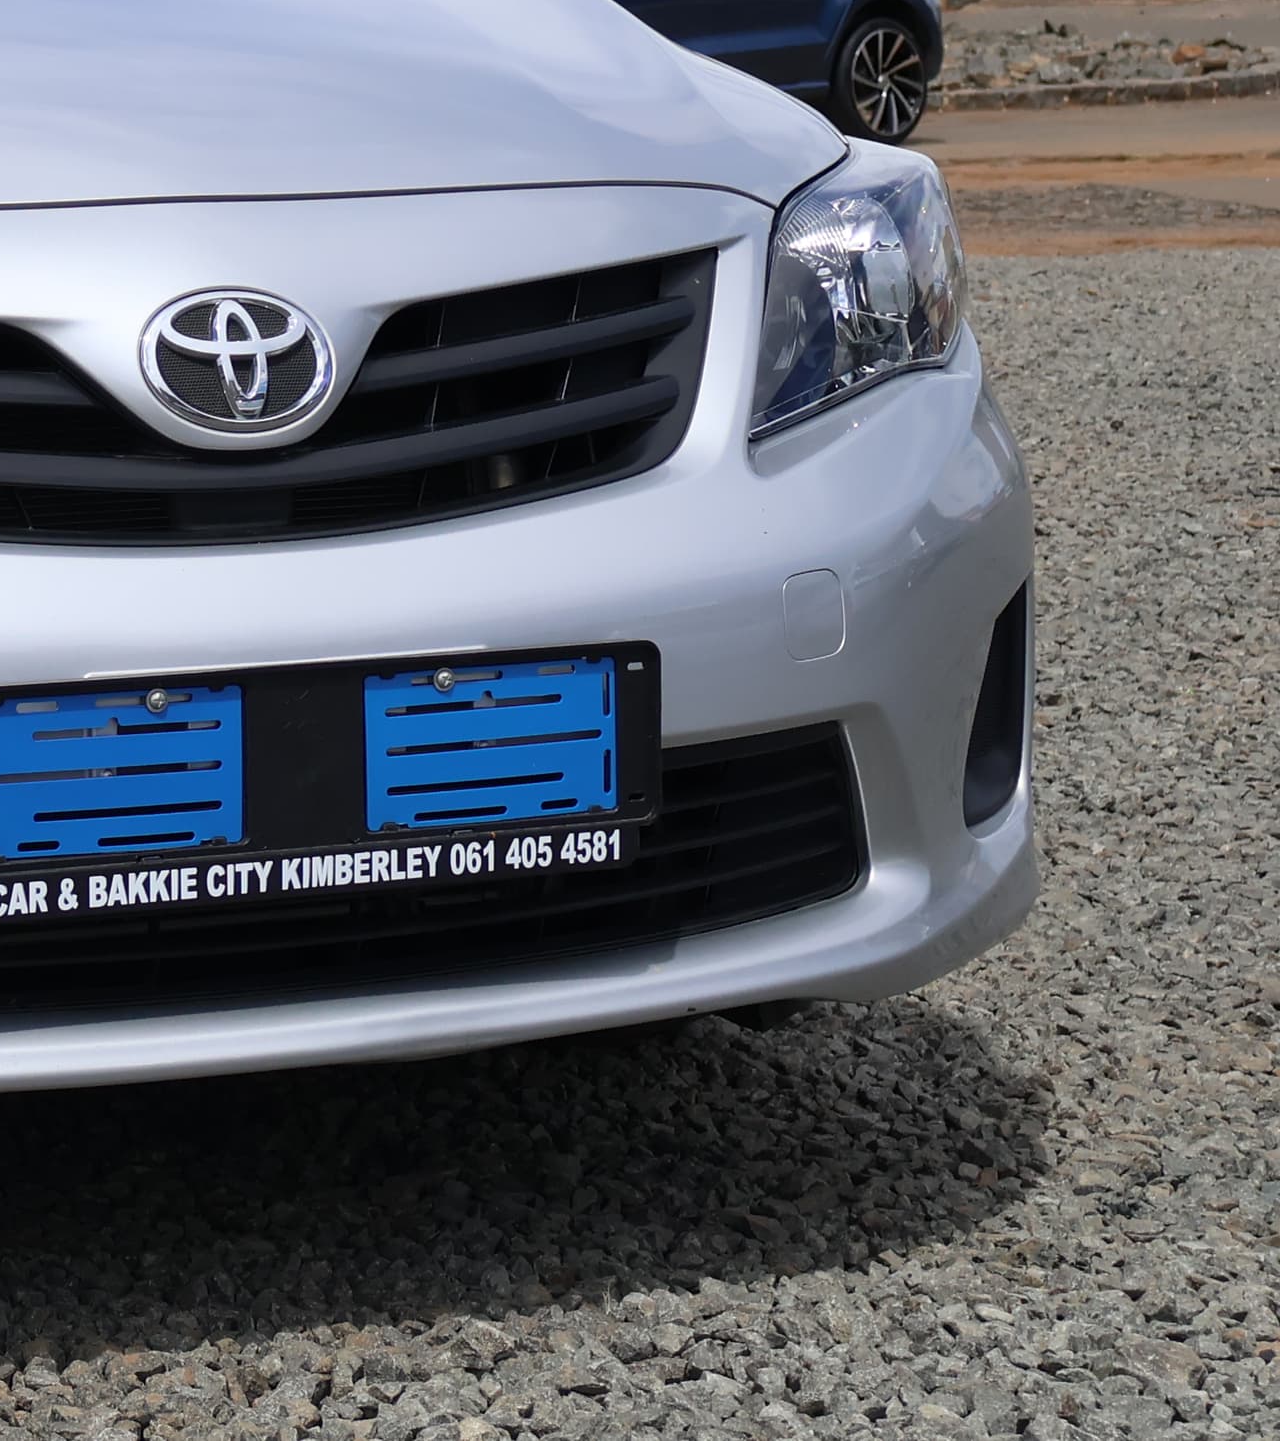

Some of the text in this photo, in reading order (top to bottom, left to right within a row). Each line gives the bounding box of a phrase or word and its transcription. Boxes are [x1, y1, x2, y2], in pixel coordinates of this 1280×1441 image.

[57, 877, 79, 910] &
[89, 867, 198, 908] BAKKIE
[206, 860, 273, 898] CITY
[281, 844, 441, 890] KIMBERLEY
[450, 840, 495, 875] 061
[505, 835, 552, 870] 405
[560, 828, 622, 864] 4581
